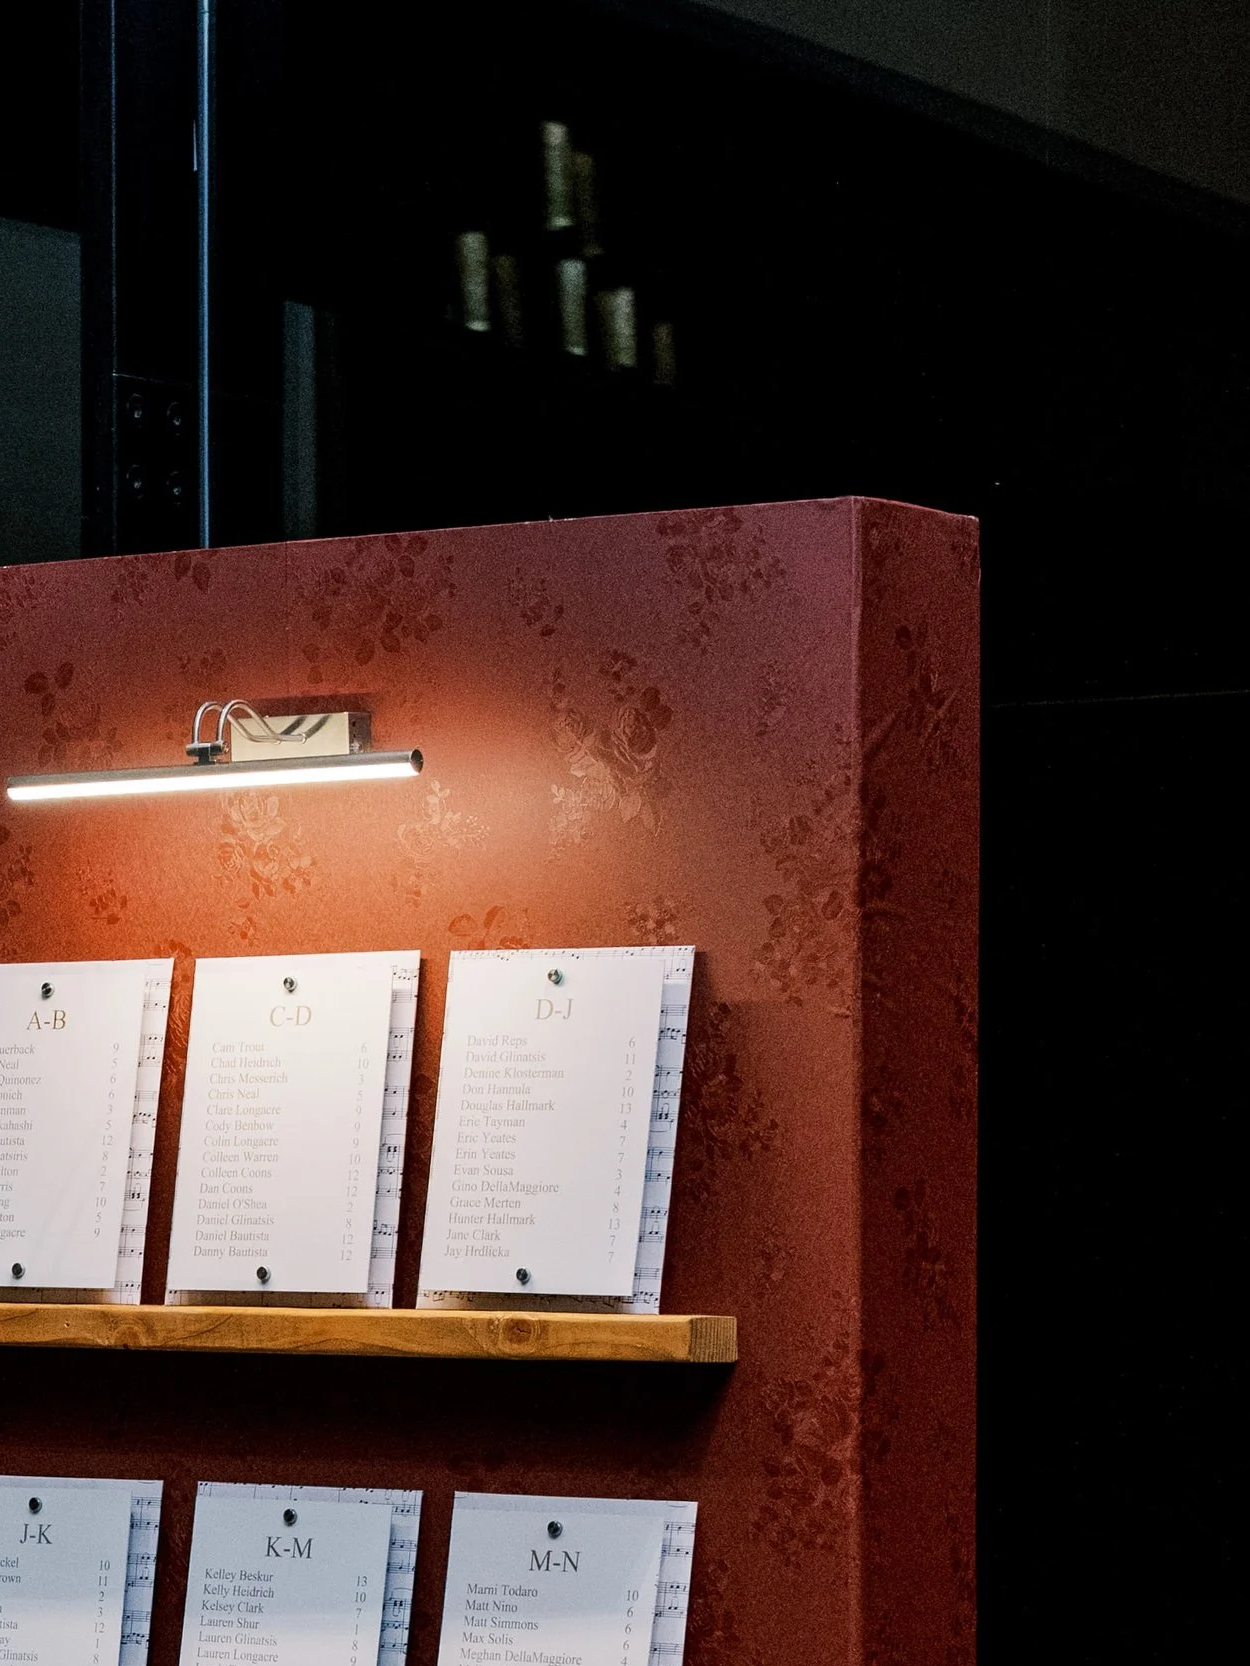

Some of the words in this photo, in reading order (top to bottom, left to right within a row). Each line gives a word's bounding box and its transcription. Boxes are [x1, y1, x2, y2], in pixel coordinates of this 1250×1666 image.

[270, 1005, 312, 1027] C-D
[535, 998, 574, 1021] D-J
[27, 1010, 66, 1030] A-B
[113, 1043, 119, 1053] 9
[102, 1136, 113, 1145] 12
[454, 1164, 480, 1175] Evan
[483, 1165, 514, 1176] Sousa
[616, 1169, 622, 1180] 3
[200, 1183, 219, 1194] Dan
[222, 1184, 253, 1194] Coons
[347, 1186, 357, 1196] 12
[452, 1180, 477, 1192] Gino
[614, 1186, 620, 1196] 4
[96, 1212, 101, 1222] 5
[197, 1215, 228, 1225] Daniel
[346, 1218, 352, 1228] 8
[448, 1213, 484, 1224] Hunter
[487, 1214, 535, 1225] Hallmark
[608, 1219, 620, 1230] 13
[94, 1228, 100, 1238] 9
[446, 1229, 470, 1241] Jane
[472, 1229, 501, 1240] Clark
[609, 1235, 616, 1246] 7
[193, 1246, 225, 1259] Danny
[229, 1246, 268, 1257] Bautista
[341, 1250, 352, 1260] 12
[19, 1523, 53, 1544] J-K
[265, 1536, 314, 1559] K-M
[100, 1560, 110, 1571] 10
[529, 1549, 581, 1572] M-N
[99, 1576, 107, 1586] 11
[205, 1569, 236, 1581] Kelley
[240, 1570, 274, 1582] Beskur
[357, 1576, 367, 1586] 13
[99, 1591, 104, 1601] 2
[204, 1584, 230, 1597] Kelly
[232, 1585, 274, 1598] Heidrich
[355, 1592, 366, 1603] 10
[202, 1600, 234, 1613] Kelsey
[237, 1601, 264, 1614] Clark
[356, 1608, 362, 1618] 7
[465, 1600, 490, 1612] Matt
[492, 1601, 518, 1613] Nino
[627, 1606, 633, 1617] 6
[200, 1616, 234, 1627] Lauren
[237, 1617, 260, 1629] Shur
[464, 1616, 488, 1628] Matt
[491, 1617, 539, 1630] Simmons
[625, 1623, 631, 1634] 6
